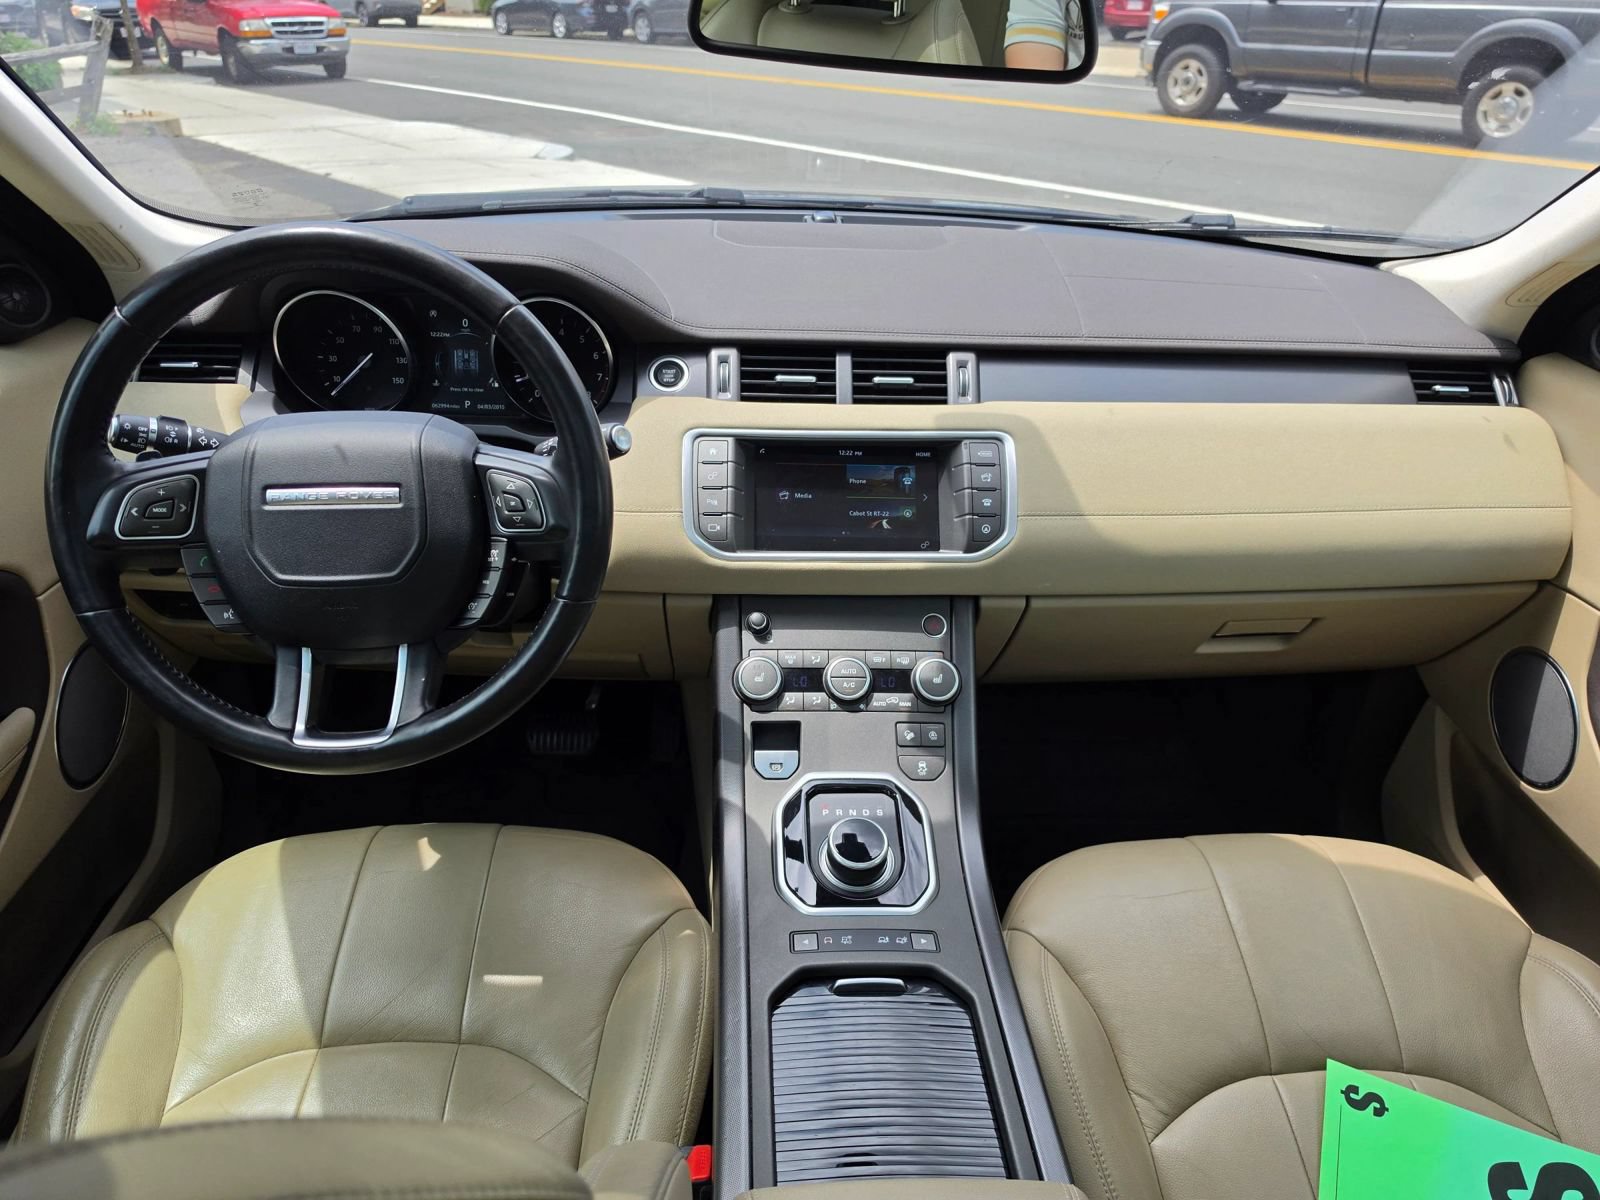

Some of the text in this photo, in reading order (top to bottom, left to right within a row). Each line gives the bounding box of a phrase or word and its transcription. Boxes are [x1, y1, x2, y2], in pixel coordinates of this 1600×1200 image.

[462, 318, 469, 327] 0
[395, 356, 408, 364] 130
[593, 351, 599, 360] 6
[333, 375, 341, 383] 10
[392, 377, 405, 385] 150
[596, 372, 603, 381] 7
[464, 400, 471, 409] P
[271, 490, 397, 501] RANGE ROVER
[822, 808, 884, 817] P R N D S
[1340, 1084, 1389, 1118] $
